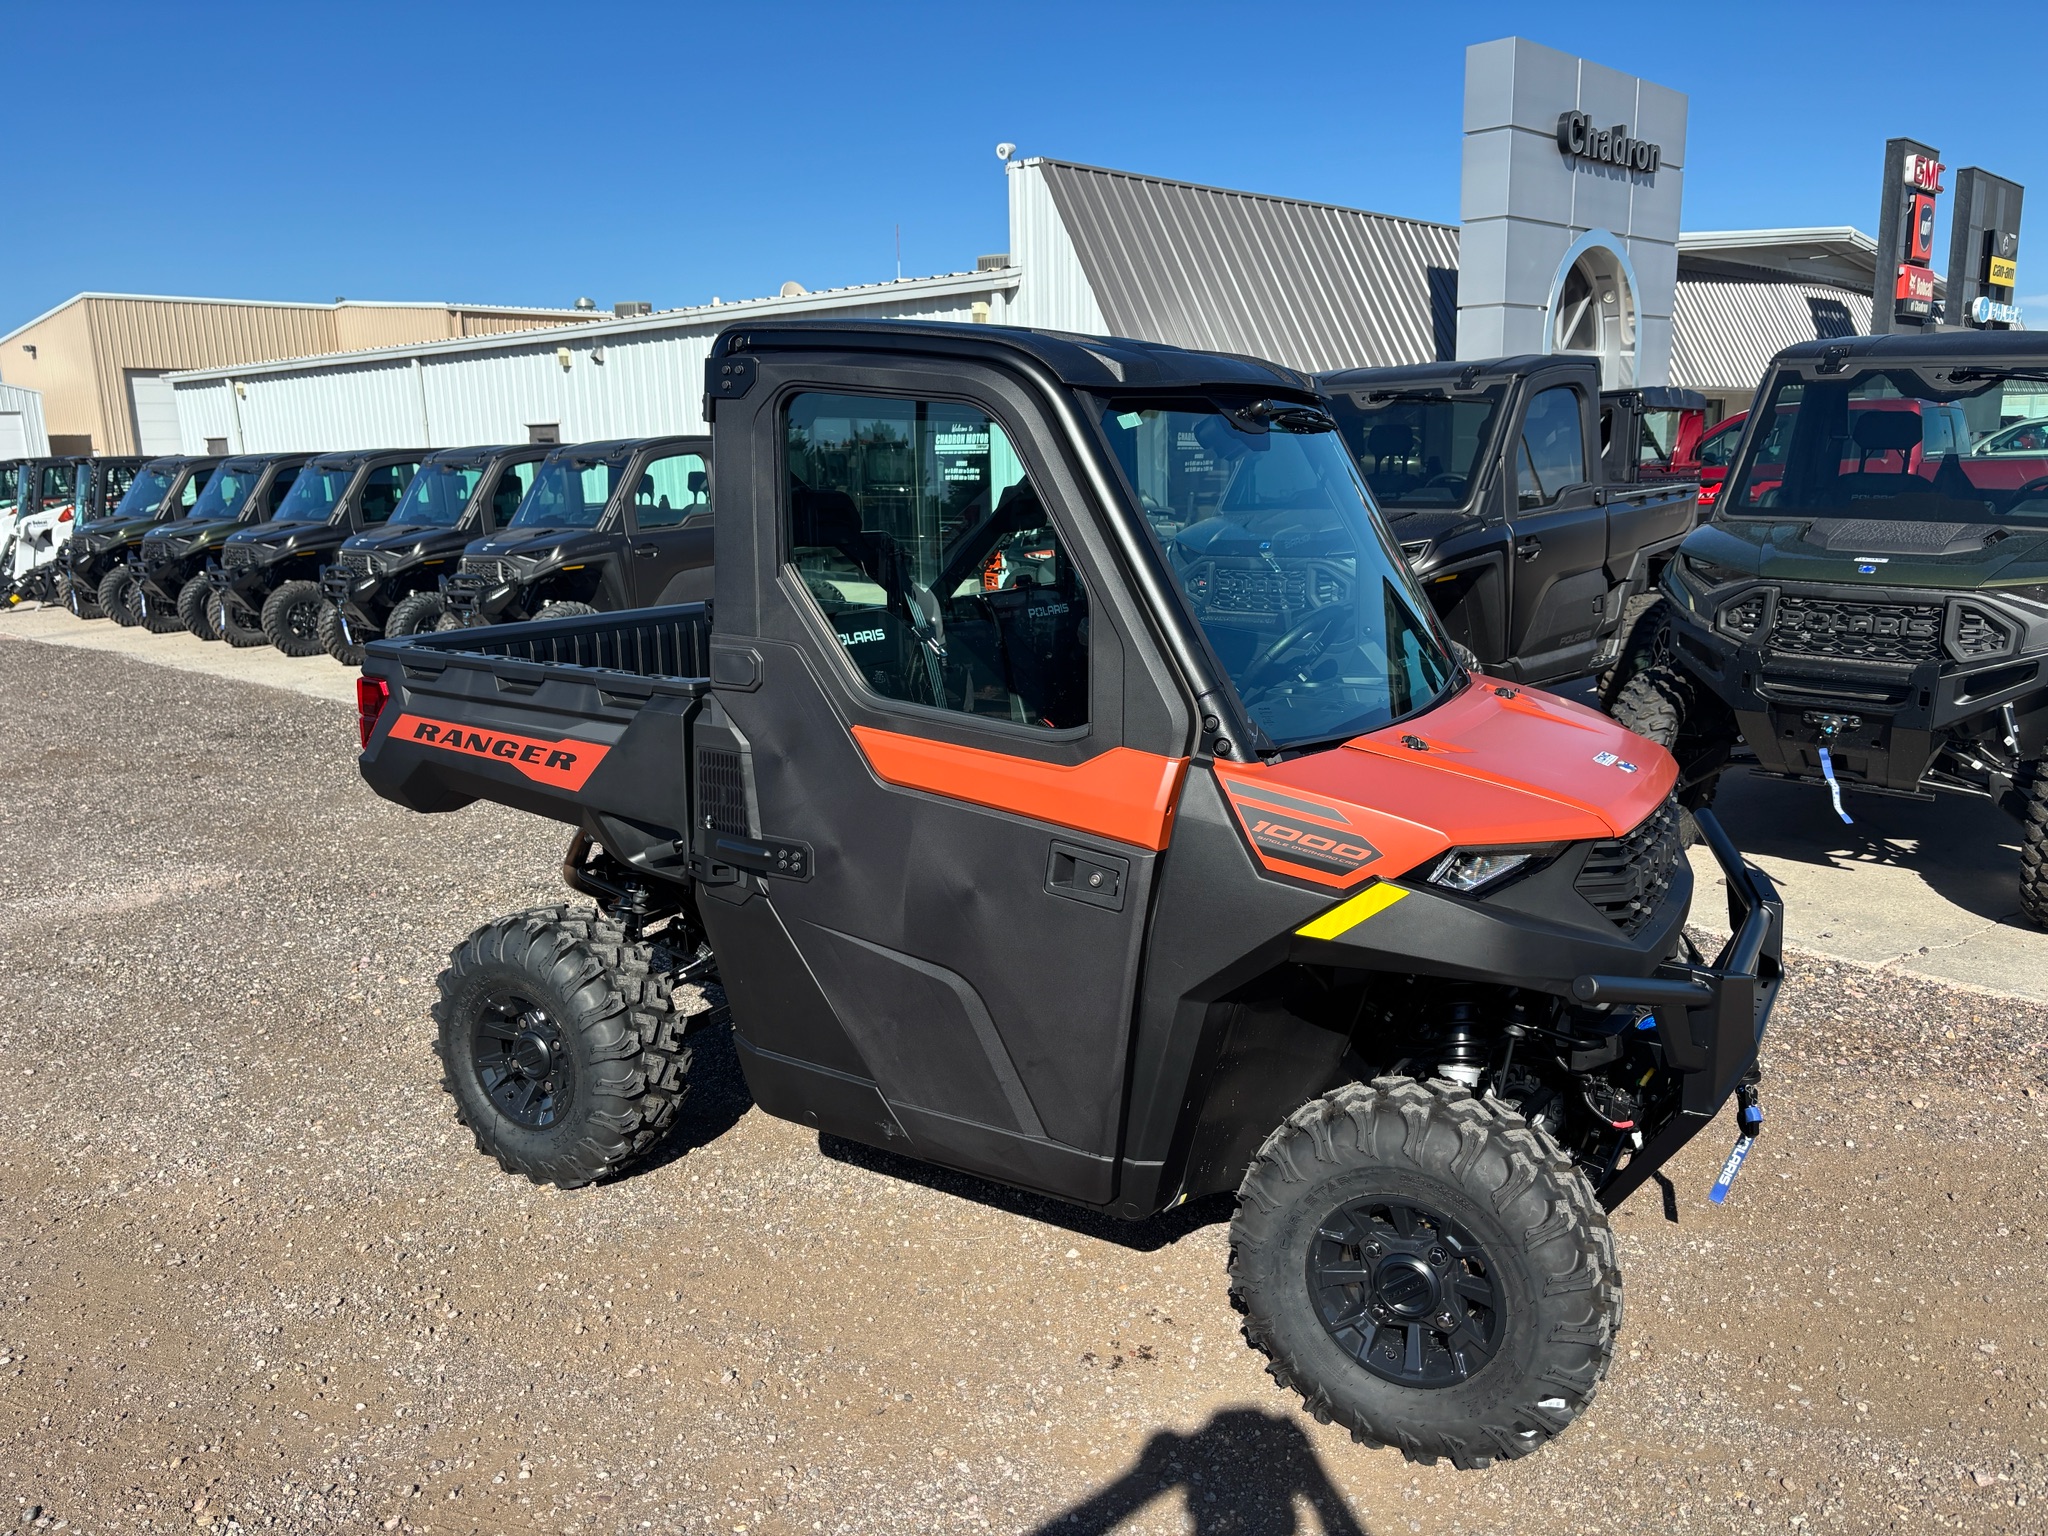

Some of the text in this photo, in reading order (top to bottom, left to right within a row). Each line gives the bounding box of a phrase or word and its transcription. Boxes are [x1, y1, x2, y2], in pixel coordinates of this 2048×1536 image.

[1558, 110, 1660, 172] Chadron
[1913, 154, 1946, 193] GMC
[1992, 264, 2015, 280] can-am
[1916, 277, 1933, 298] Bobcat
[935, 433, 989, 445] CHADRON MOTOR
[1028, 603, 1070, 619] POLARIS
[1782, 609, 1935, 638] POLARIS
[837, 628, 886, 646] OLARIS
[1559, 630, 1592, 646] POLARIS
[412, 722, 578, 772] RANGER
[1251, 820, 1373, 861] 1000
[1257, 835, 1360, 867] SINGLE OVERHEAD CAM
[1718, 1136, 1753, 1186] OLARIS
